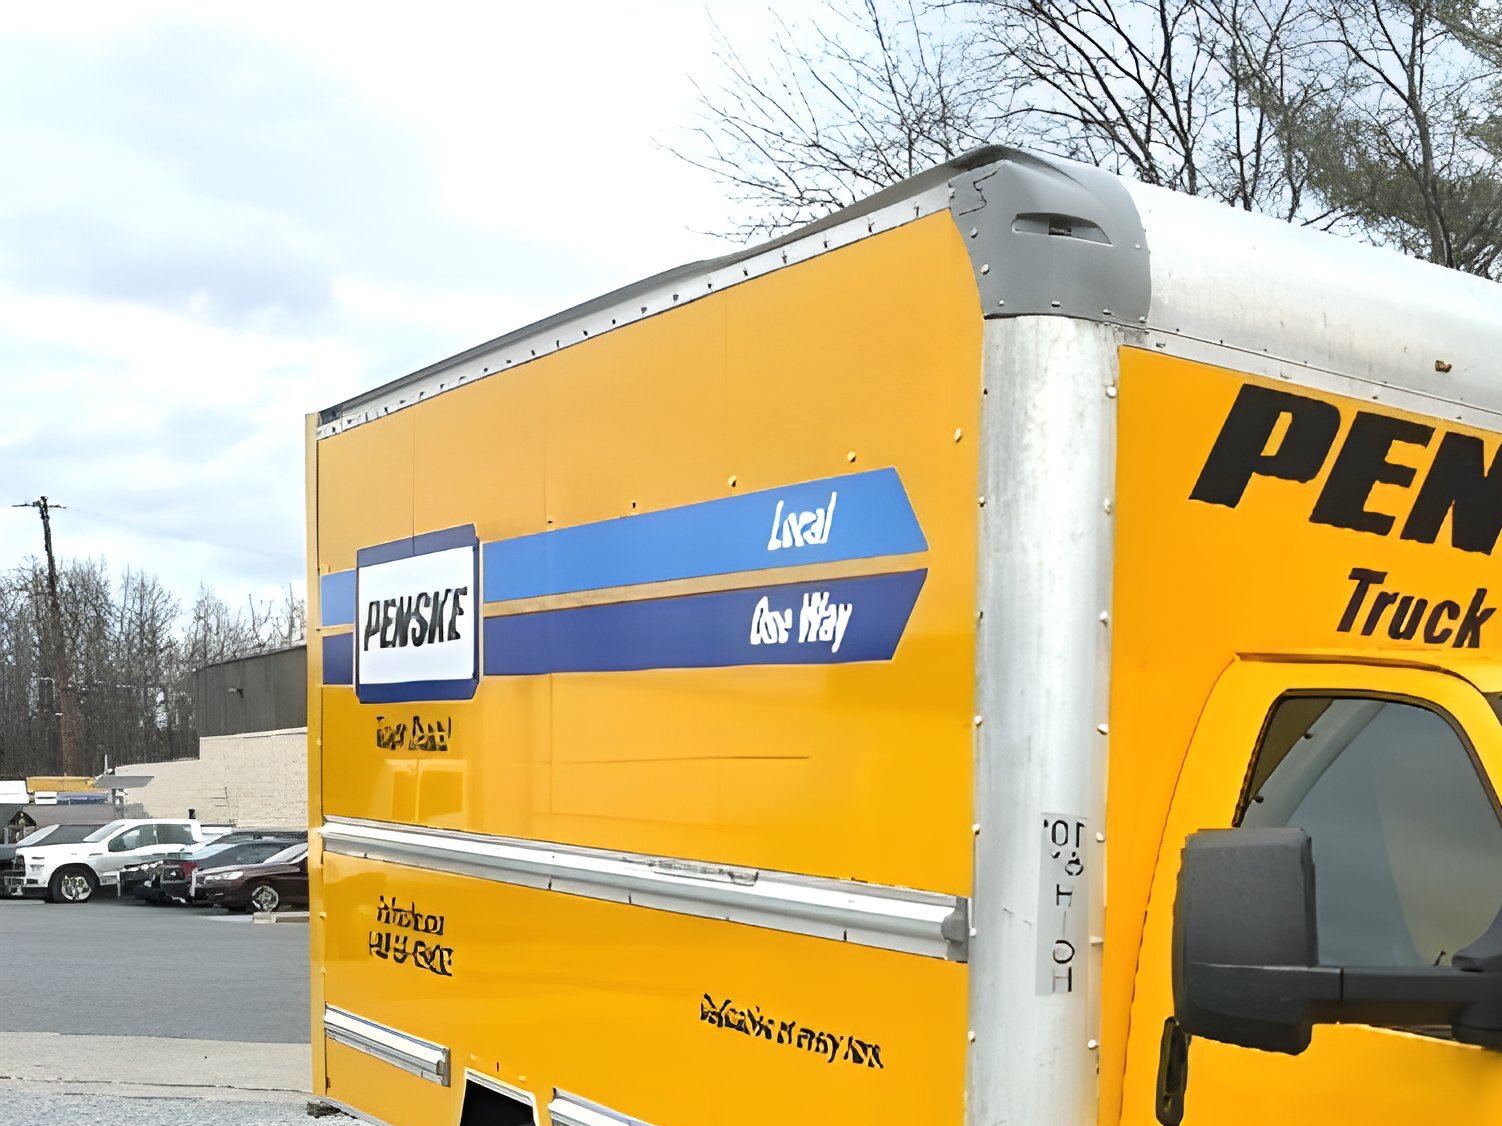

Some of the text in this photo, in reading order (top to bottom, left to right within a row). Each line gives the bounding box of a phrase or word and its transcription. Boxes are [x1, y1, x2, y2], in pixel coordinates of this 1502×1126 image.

[364, 586, 468, 652] PENSKE
[798, 592, 853, 653] Way
[1336, 567, 1498, 649] Truck
